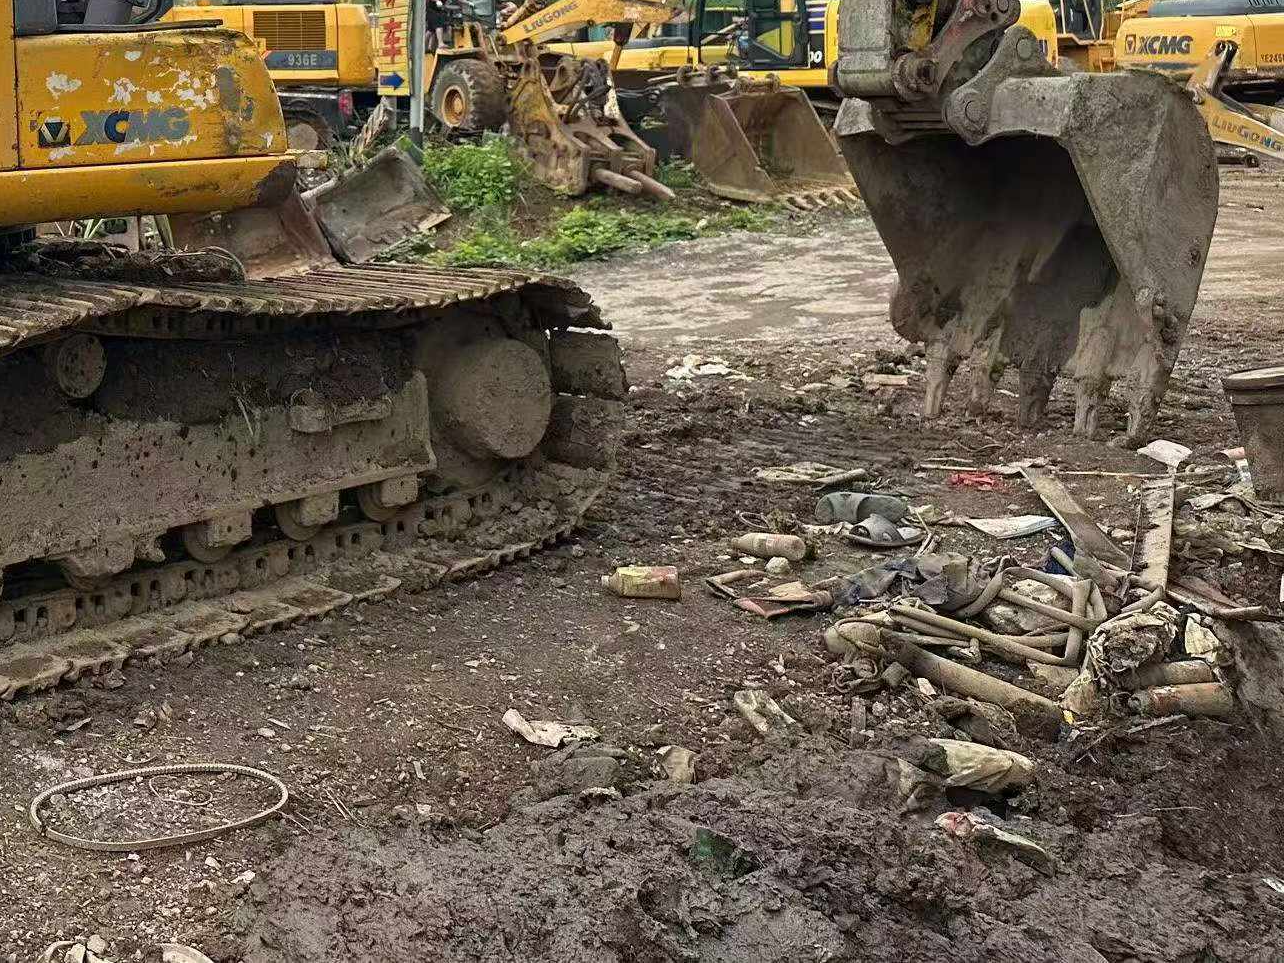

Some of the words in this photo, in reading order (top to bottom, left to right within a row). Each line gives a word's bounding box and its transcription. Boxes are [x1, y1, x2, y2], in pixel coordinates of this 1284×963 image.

[1138, 35, 1194, 54] XCMG
[288, 52, 317, 66] 936E
[75, 107, 191, 145] XCMG
